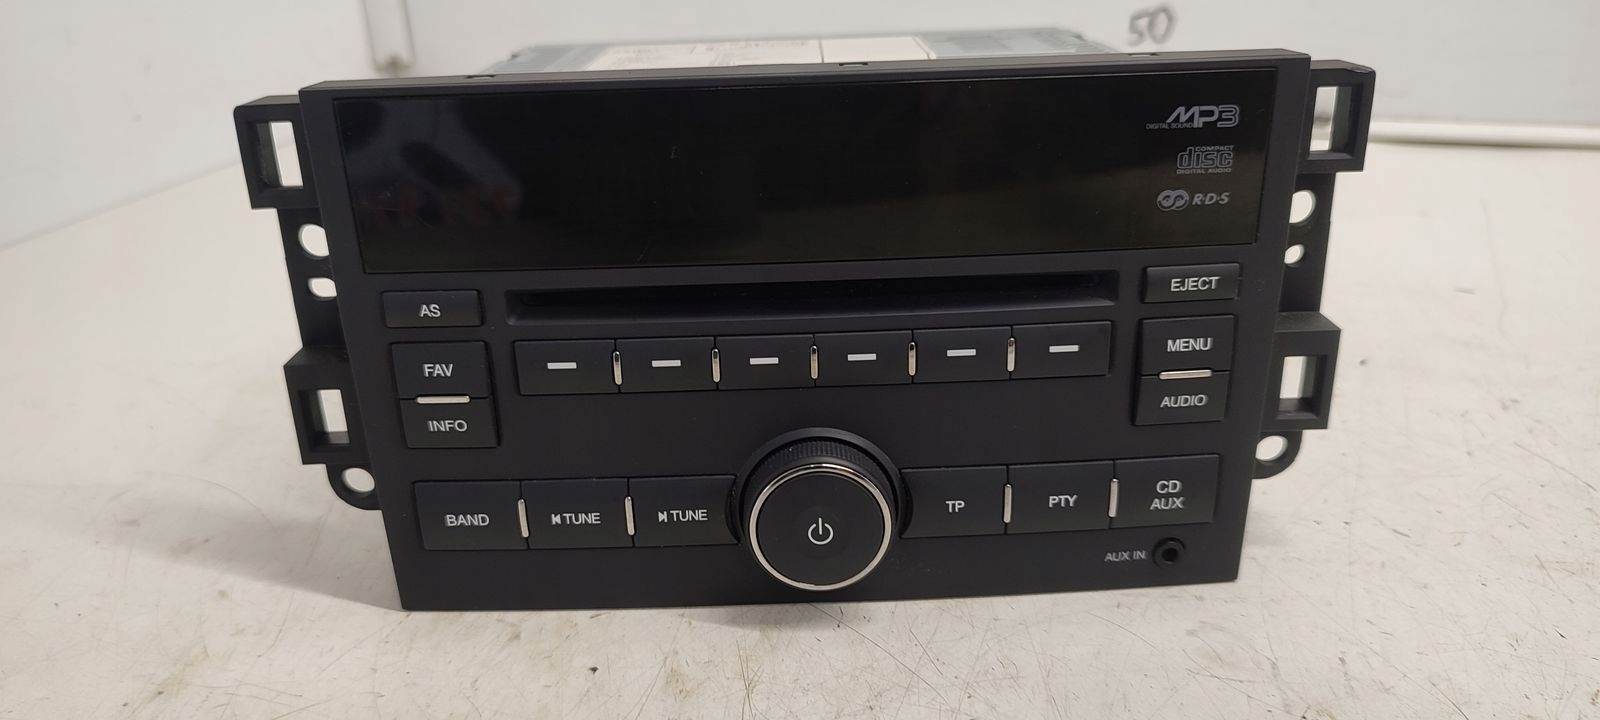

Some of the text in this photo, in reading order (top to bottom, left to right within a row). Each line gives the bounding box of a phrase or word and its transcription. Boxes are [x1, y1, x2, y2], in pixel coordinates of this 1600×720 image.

[1127, 6, 1175, 46] 50
[1165, 104, 1240, 128] MP3
[1146, 121, 1193, 130] DIGITAL SOUND
[1177, 146, 1233, 168] disc
[1170, 276, 1221, 292] EJECT
[419, 303, 441, 318] AS
[1167, 337, 1213, 352] MENU
[423, 363, 454, 377] FAV
[1159, 394, 1208, 408] AUDIO
[427, 419, 468, 432] INFO
[1156, 479, 1182, 494] CD
[945, 500, 965, 513] TP
[1048, 494, 1078, 508] PTY
[1150, 496, 1185, 510] AUX
[445, 513, 490, 527] BAND
[562, 512, 601, 525] TUNE
[670, 509, 708, 522] TUNE
[1104, 549, 1147, 562] AUX IN
